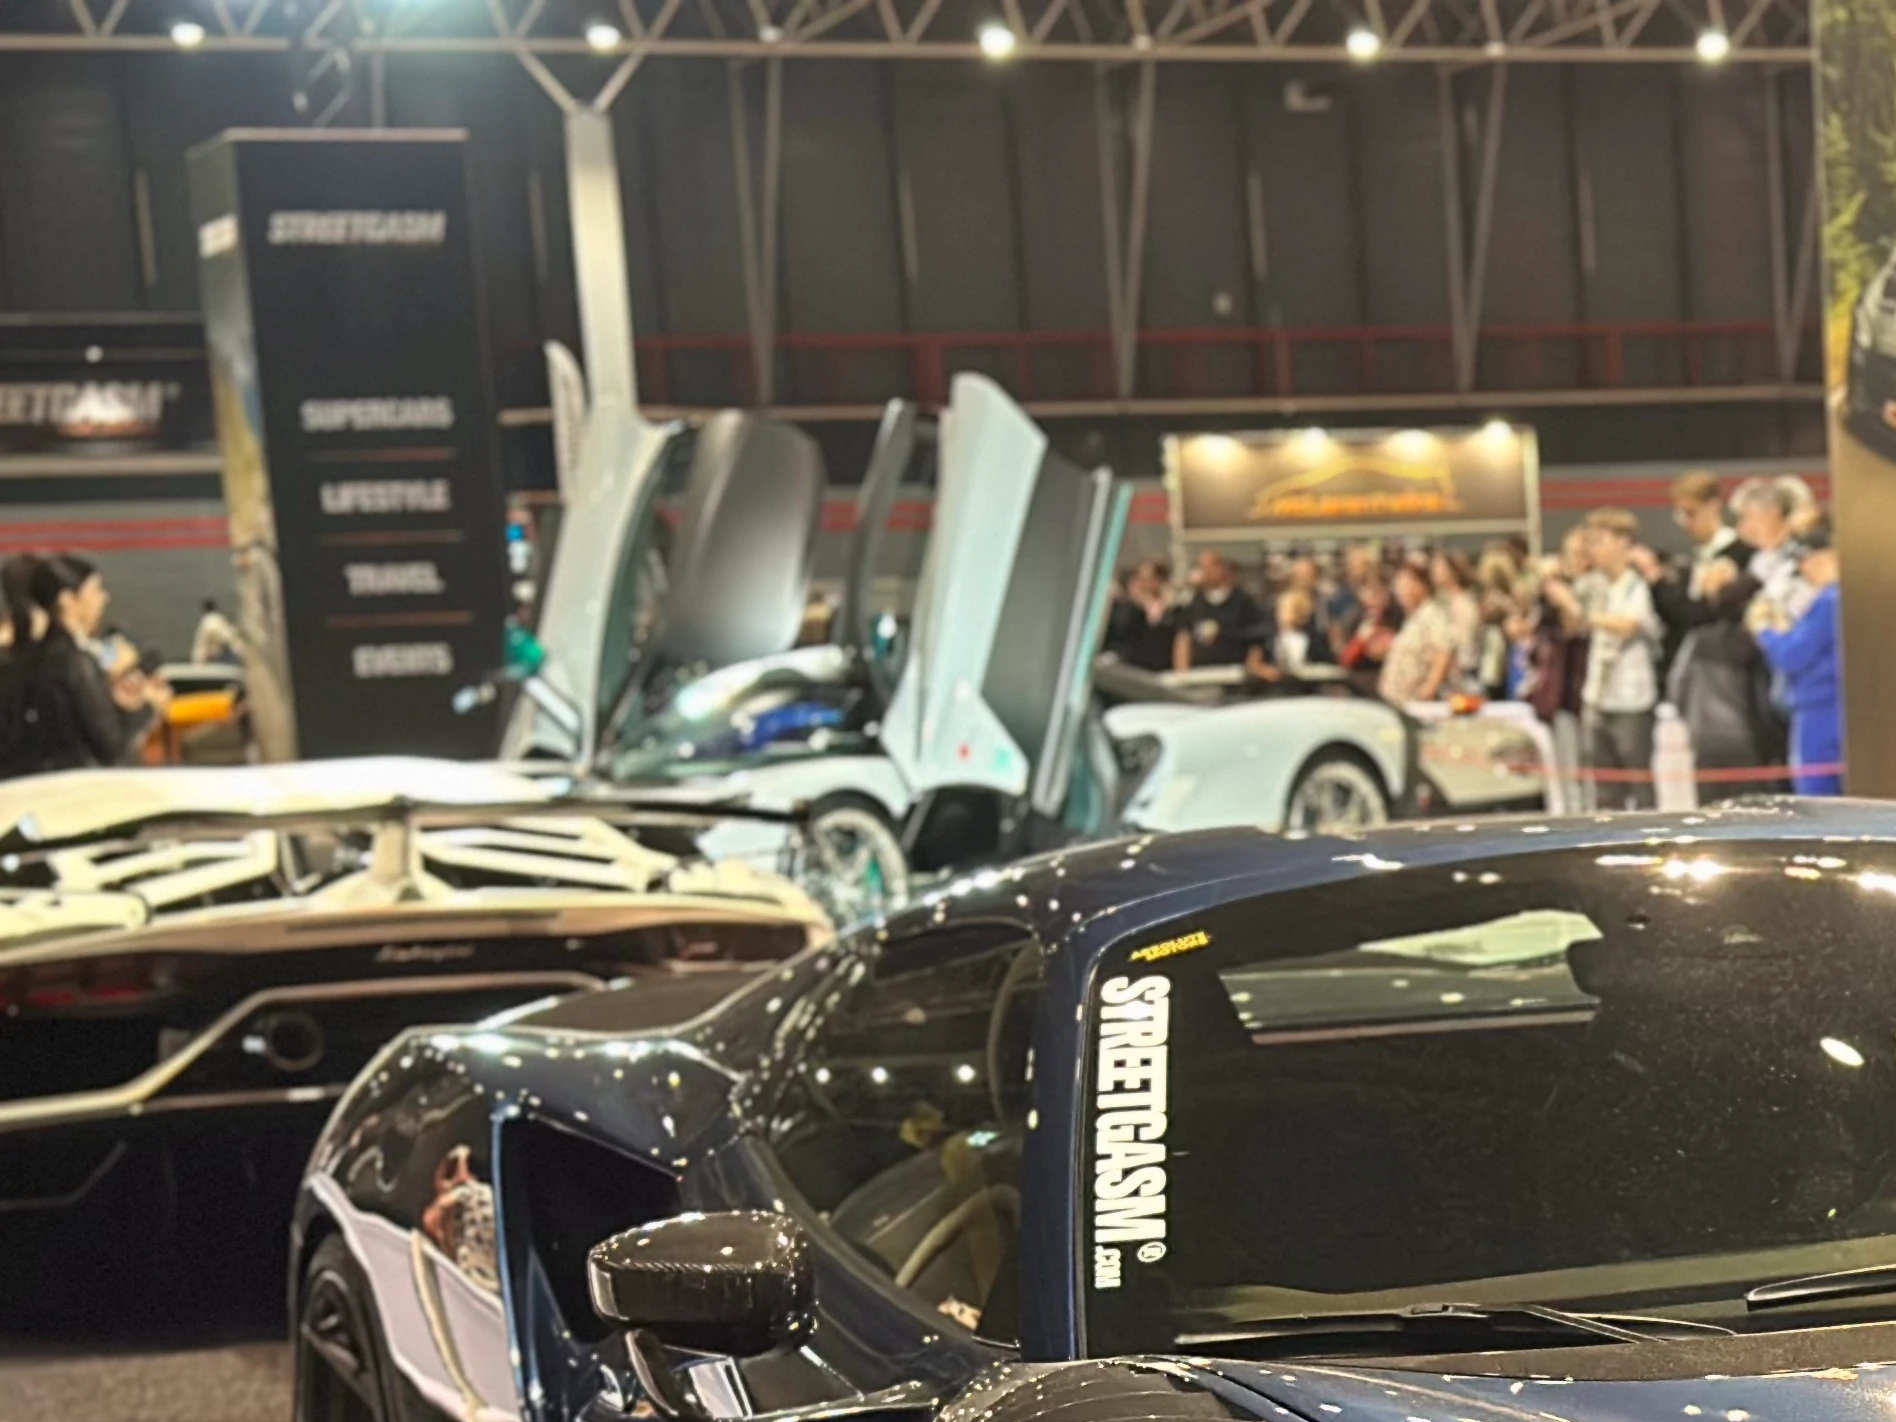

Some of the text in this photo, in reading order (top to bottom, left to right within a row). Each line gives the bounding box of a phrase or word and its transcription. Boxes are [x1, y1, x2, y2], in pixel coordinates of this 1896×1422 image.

[320, 480, 450, 514] LIFESTYLE
[344, 562, 445, 595] TRAVEL
[353, 643, 454, 677] EVENTS
